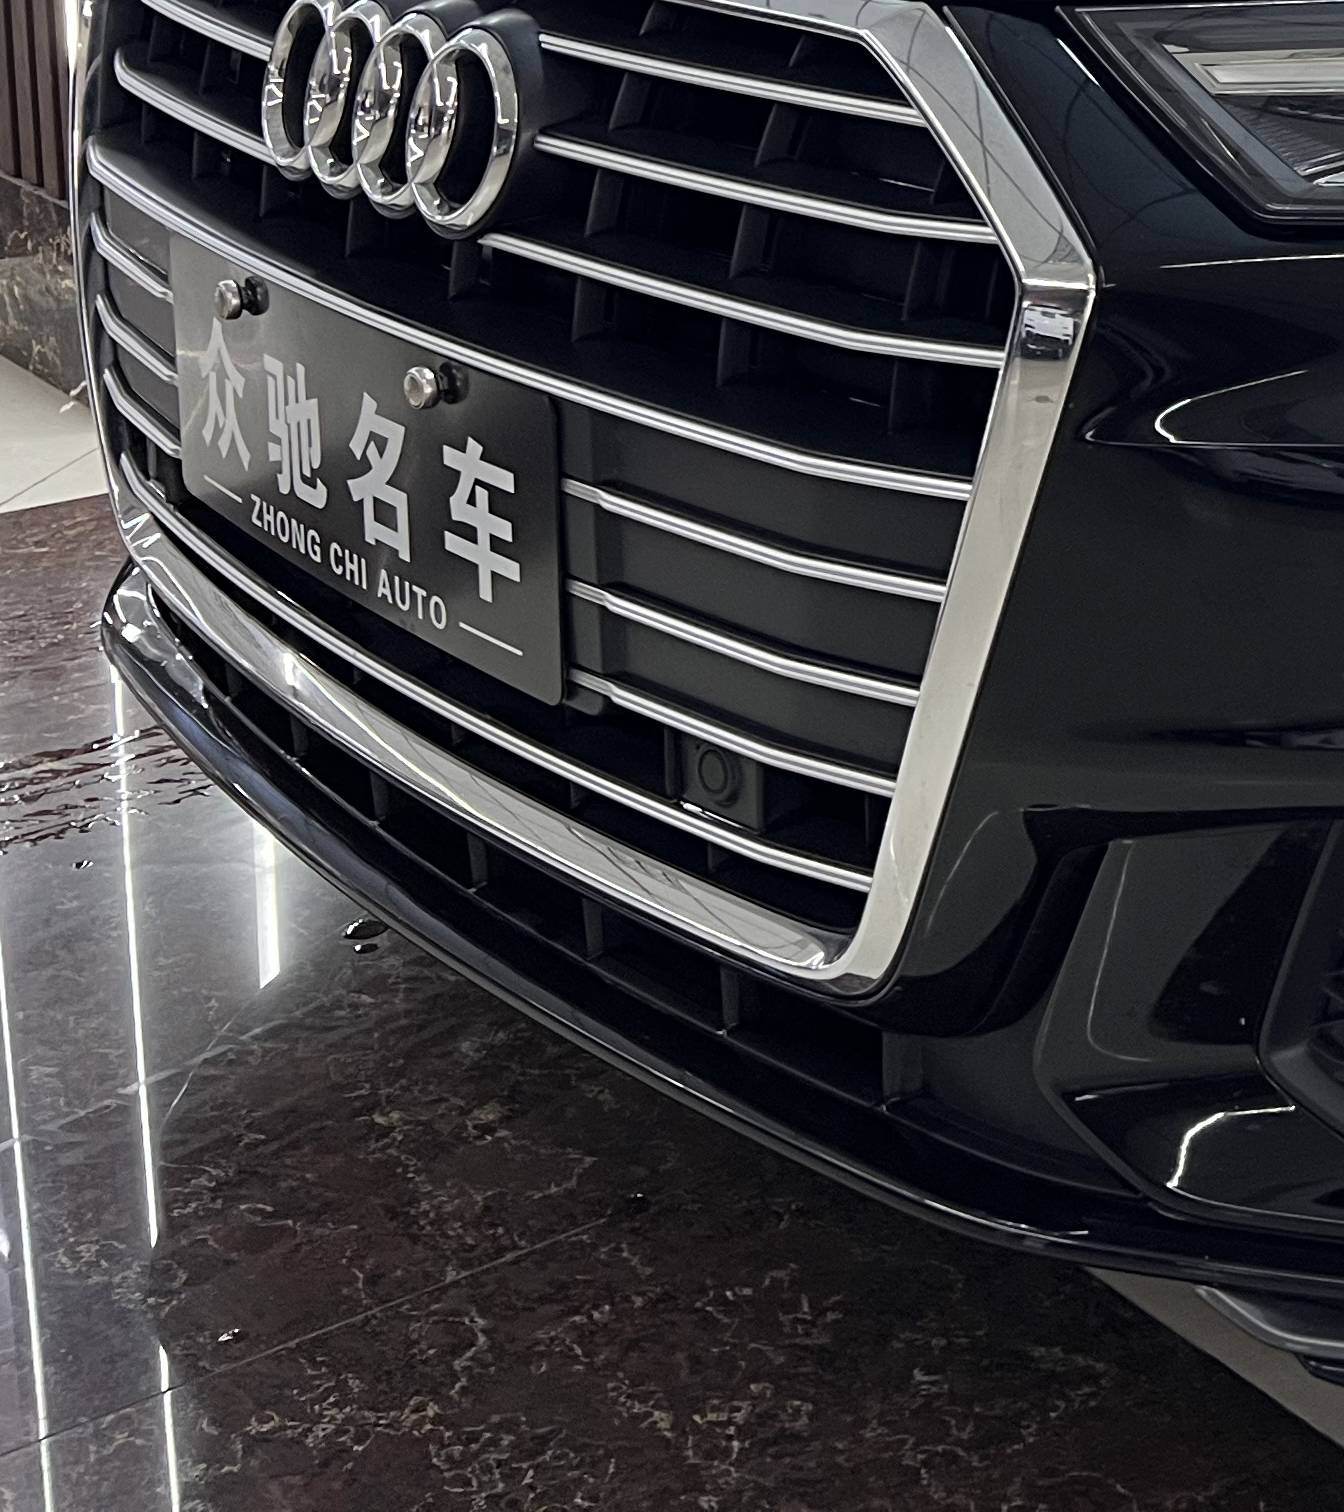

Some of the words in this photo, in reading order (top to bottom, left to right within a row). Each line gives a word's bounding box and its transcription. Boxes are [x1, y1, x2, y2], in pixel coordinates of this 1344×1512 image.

[200, 317, 521, 603] 众驰名车
[249, 493, 322, 564] ZHONG
[329, 542, 368, 590] CHI
[376, 568, 447, 630] AUTO
